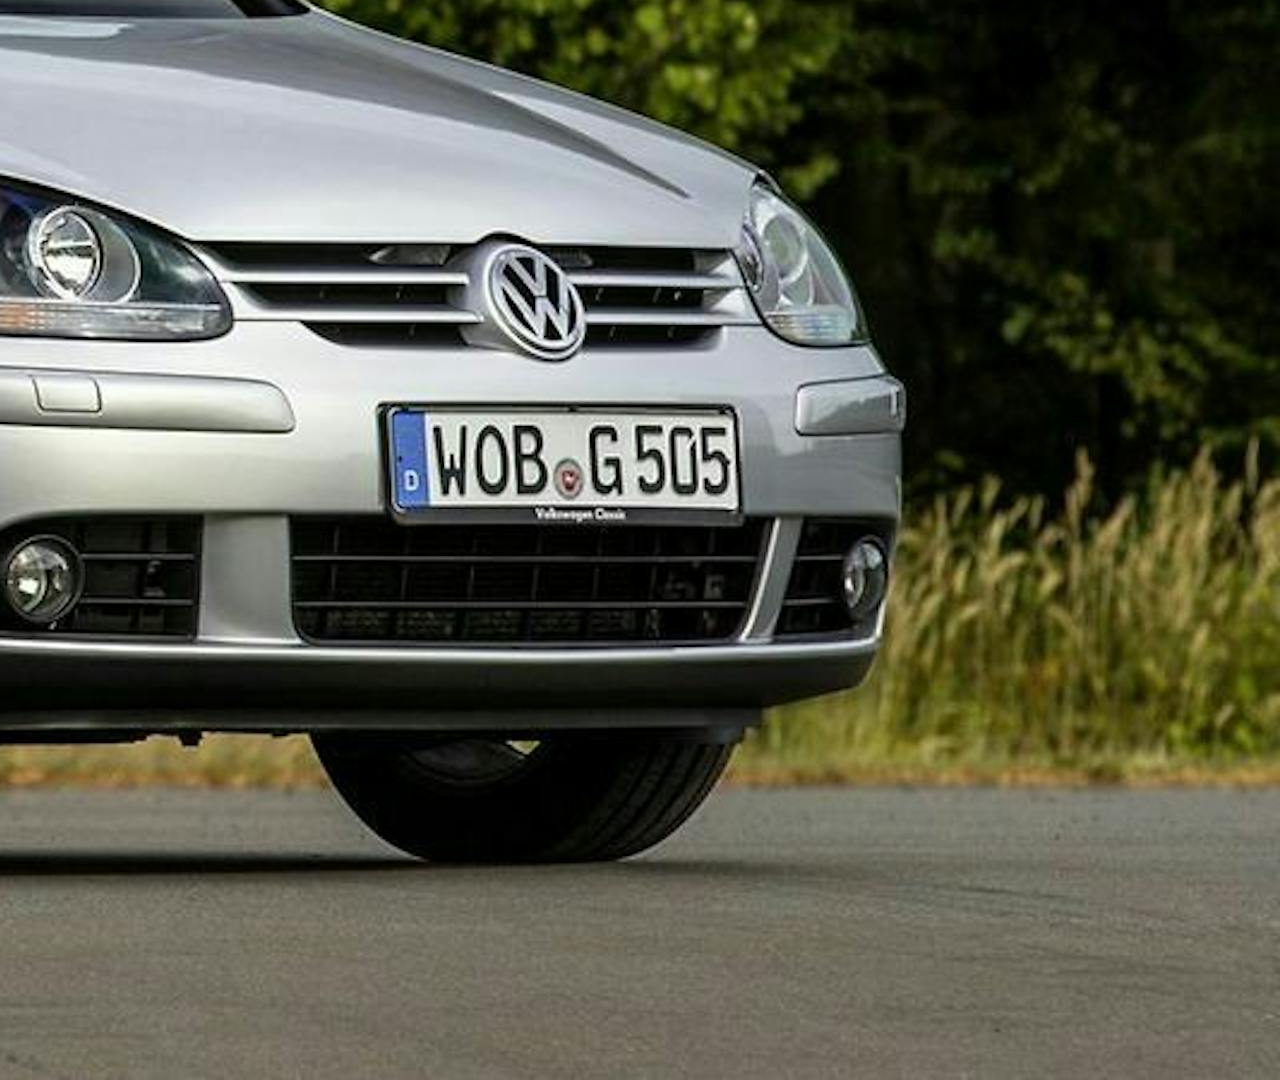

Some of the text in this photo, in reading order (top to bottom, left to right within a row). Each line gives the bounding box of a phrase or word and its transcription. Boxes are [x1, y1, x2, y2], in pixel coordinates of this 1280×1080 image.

[489, 248, 582, 355] VW
[403, 468, 420, 492] D
[432, 424, 730, 496] WOB G 505
[534, 507, 593, 523] Volkswagen
